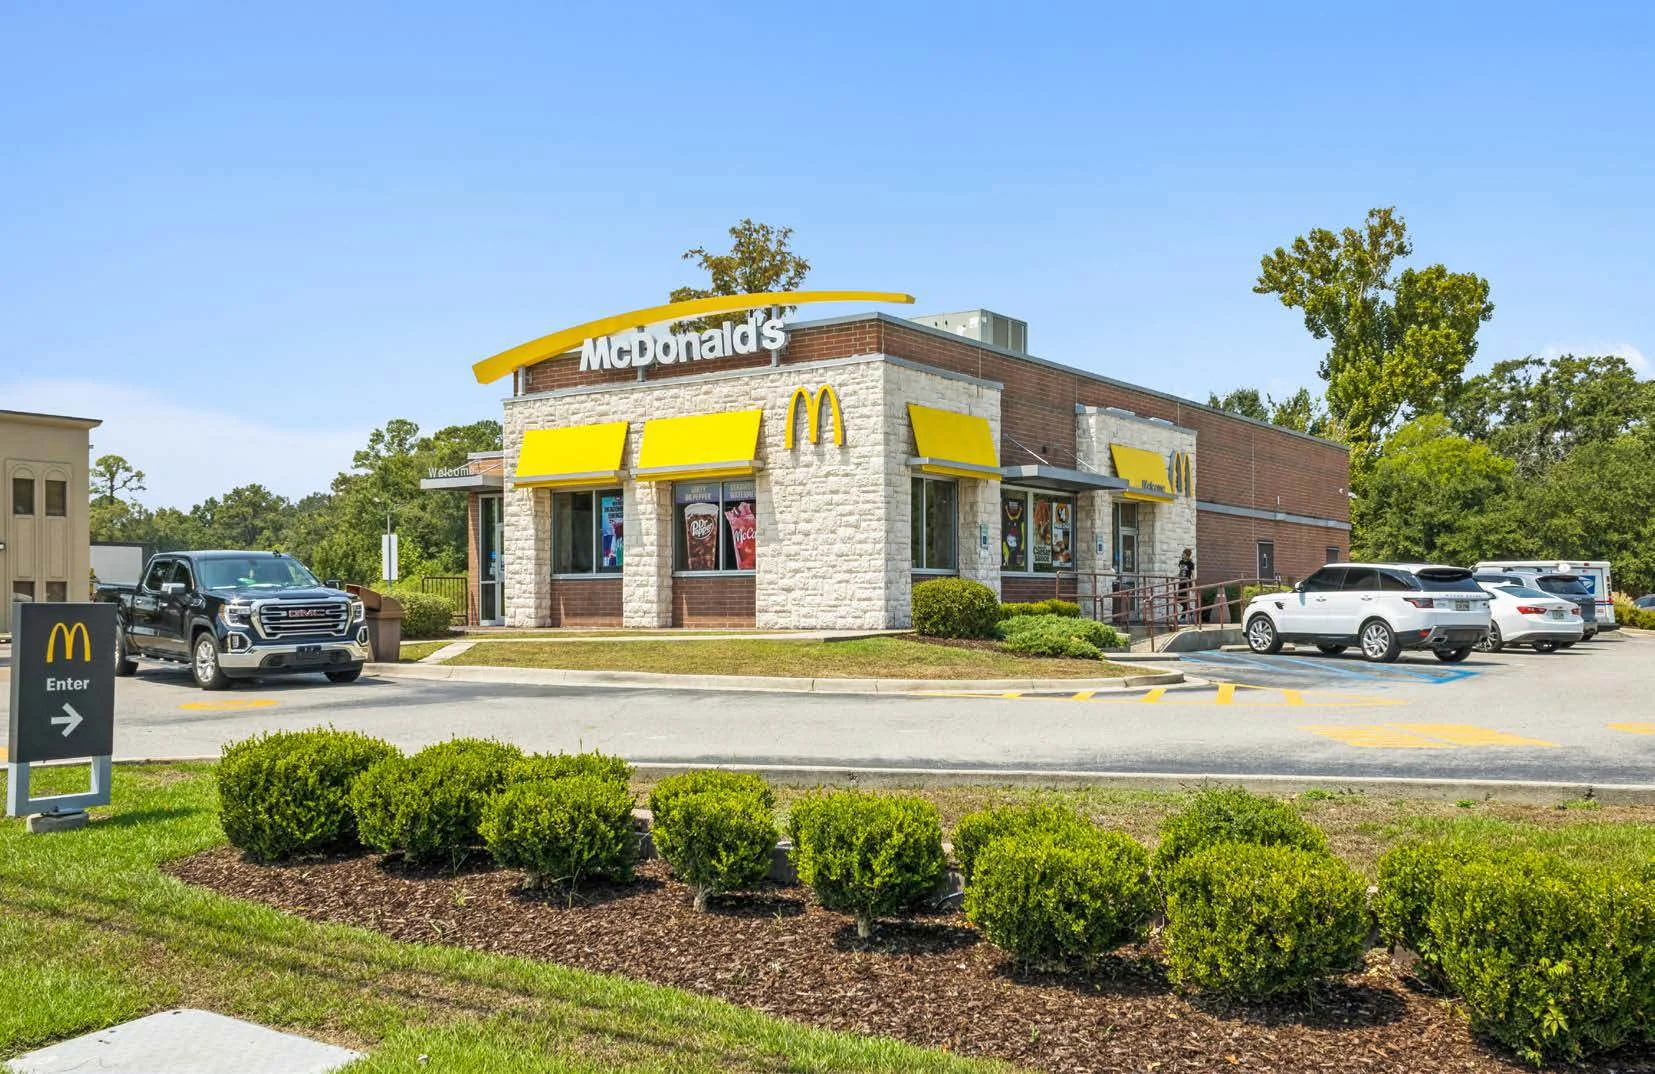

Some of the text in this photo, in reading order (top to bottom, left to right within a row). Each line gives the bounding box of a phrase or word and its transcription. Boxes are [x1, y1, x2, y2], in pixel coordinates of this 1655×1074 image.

[579, 309, 786, 371] McDonald's
[690, 520, 713, 537] Pepper
[288, 608, 326, 617] GMC
[46, 677, 90, 691] Enter
